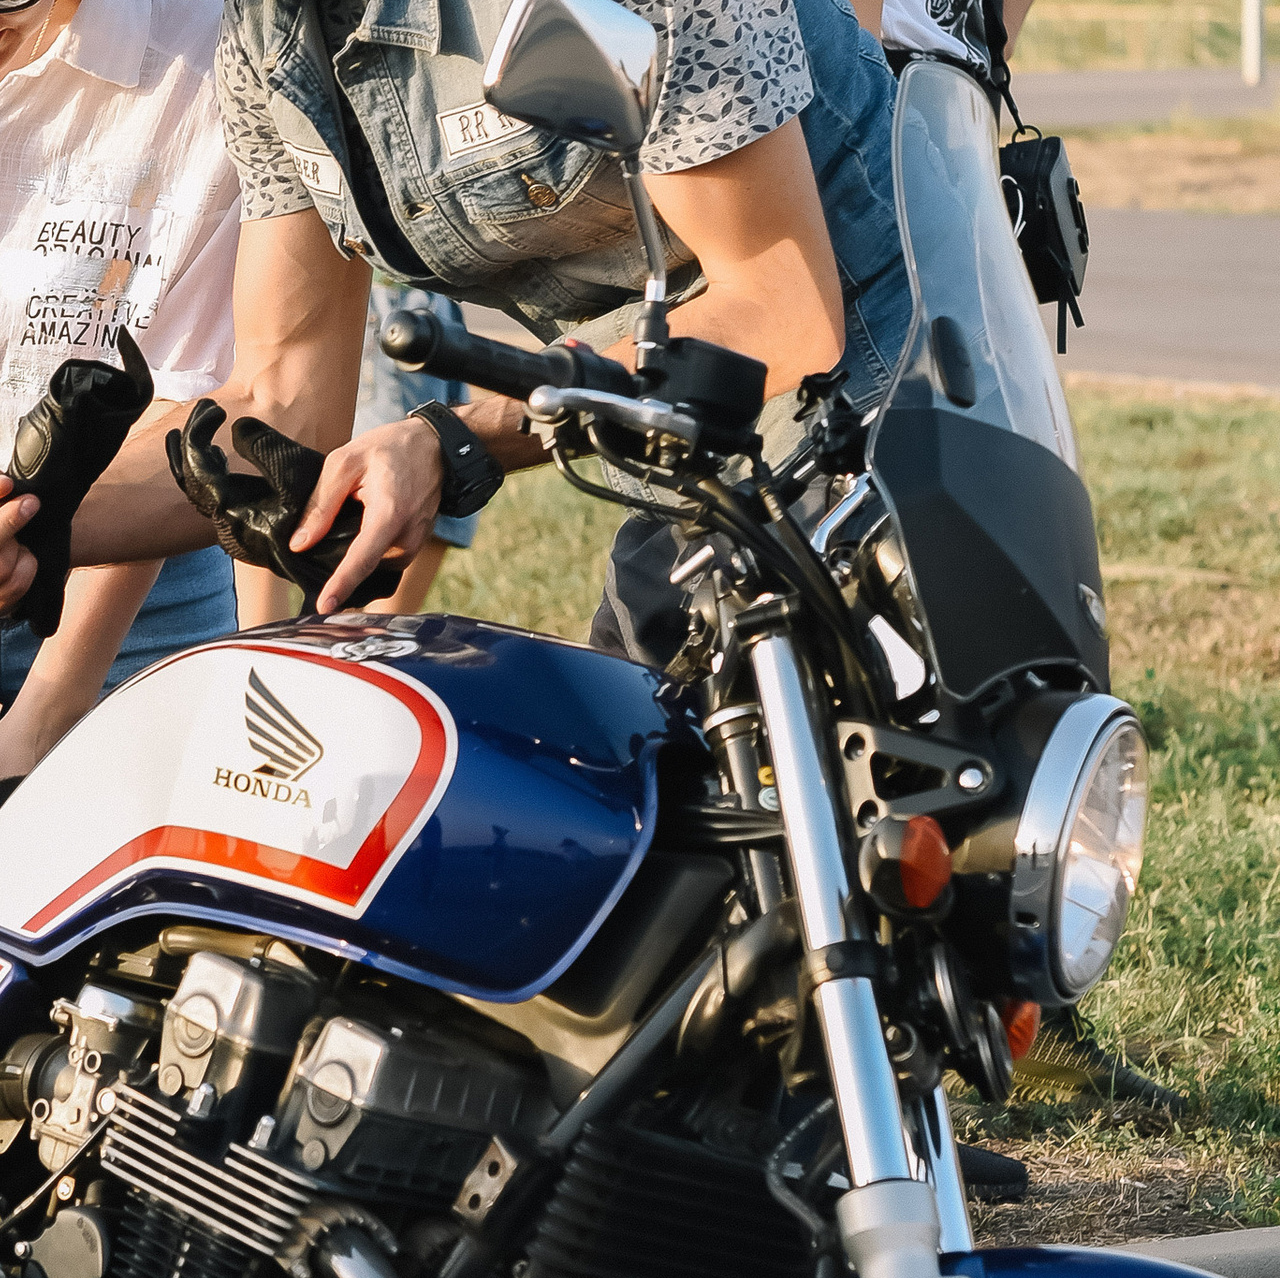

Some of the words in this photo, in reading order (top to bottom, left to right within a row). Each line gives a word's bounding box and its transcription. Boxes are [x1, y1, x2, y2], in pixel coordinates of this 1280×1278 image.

[37, 220, 141, 249] BEAUTY
[20, 321, 119, 348] AMAZIN
[213, 767, 312, 808] HONDA
